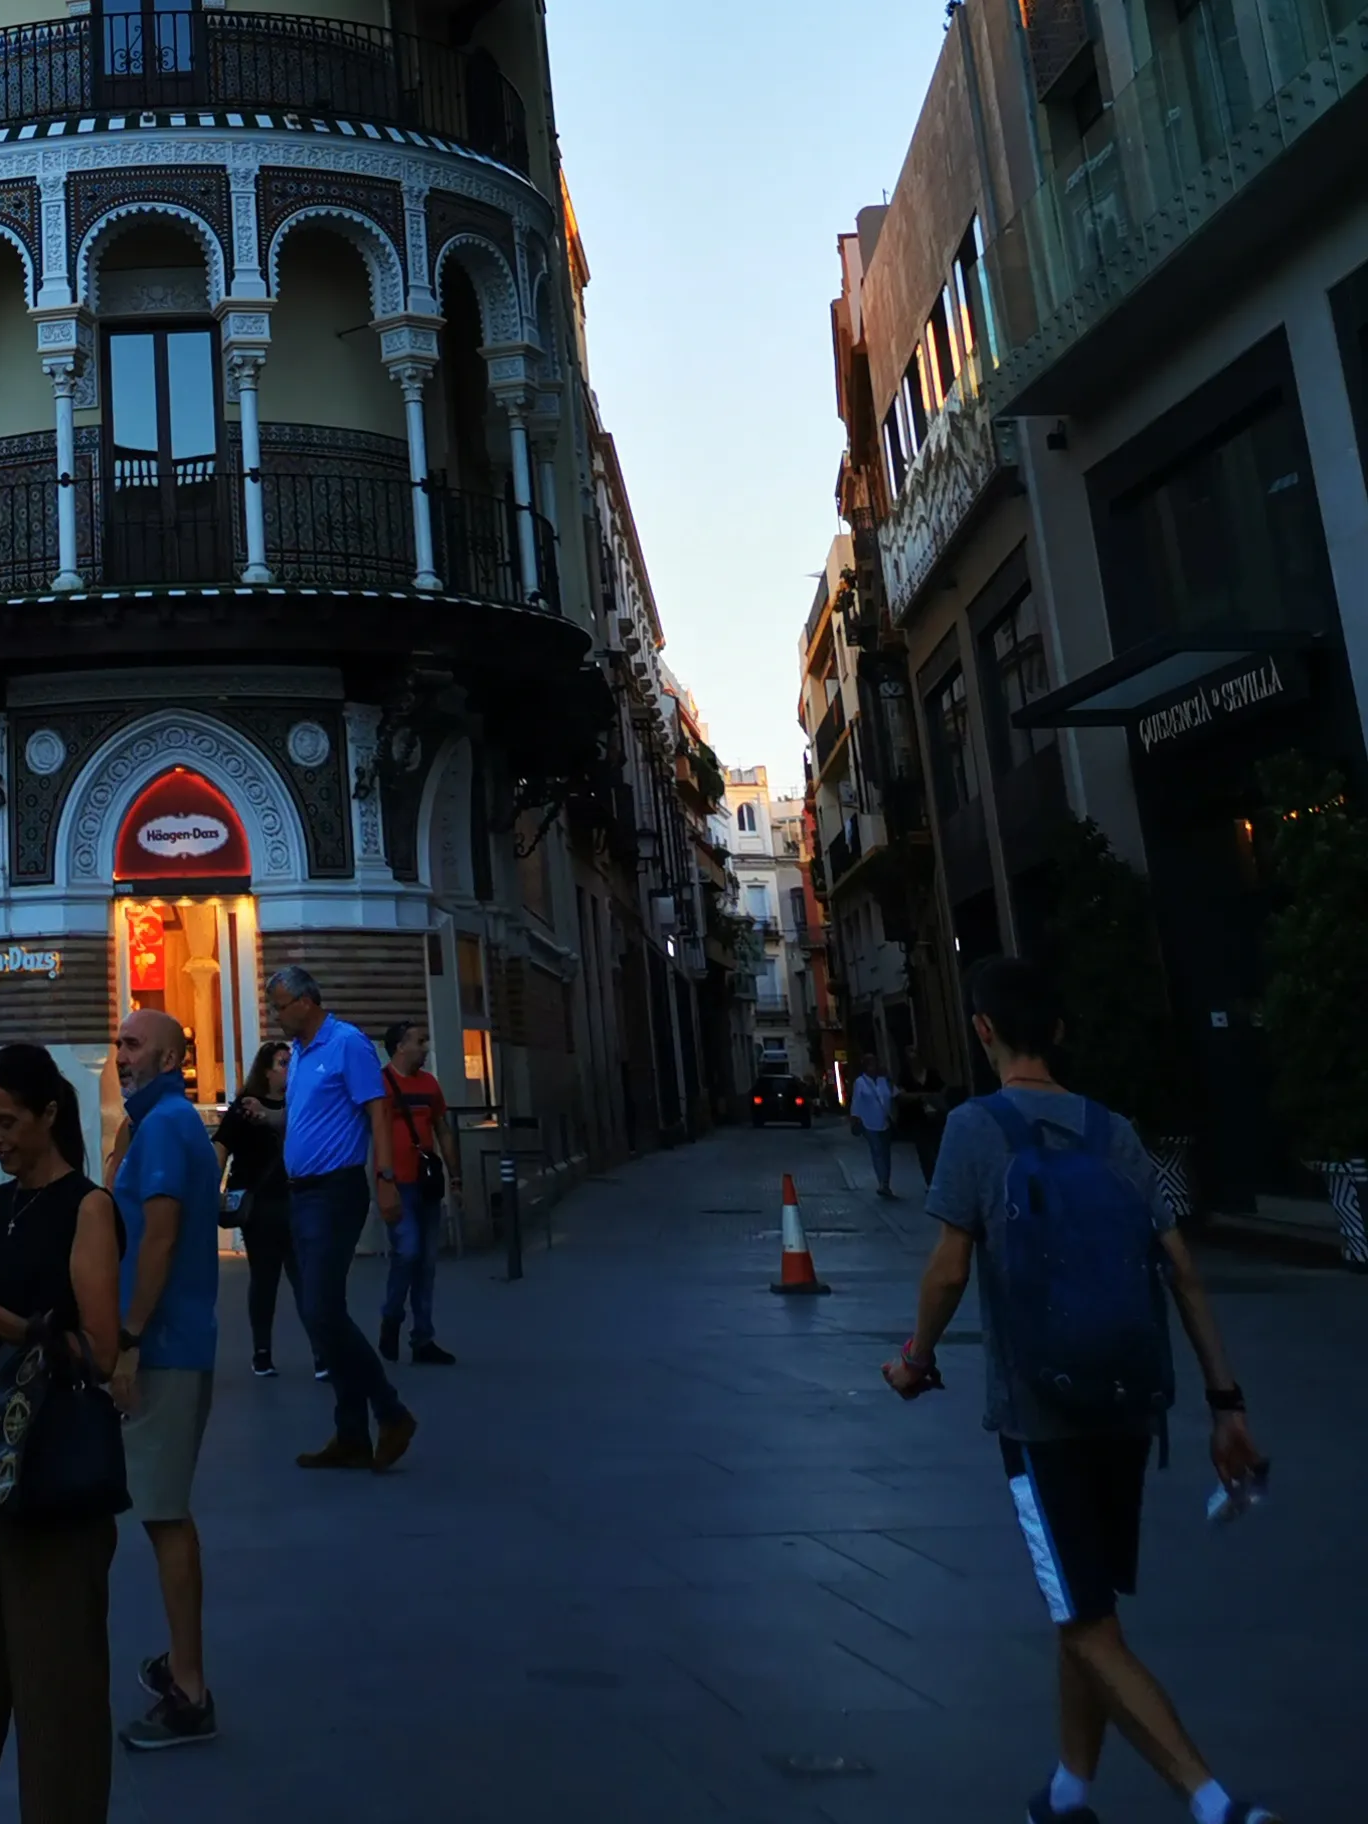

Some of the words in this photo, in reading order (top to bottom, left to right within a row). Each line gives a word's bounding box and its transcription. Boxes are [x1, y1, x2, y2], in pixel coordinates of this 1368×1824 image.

[1139, 685, 1212, 754] QUERENCIA
[1221, 655, 1284, 712] SEVILLA
[146, 827, 220, 843] Häagen-Dazs
